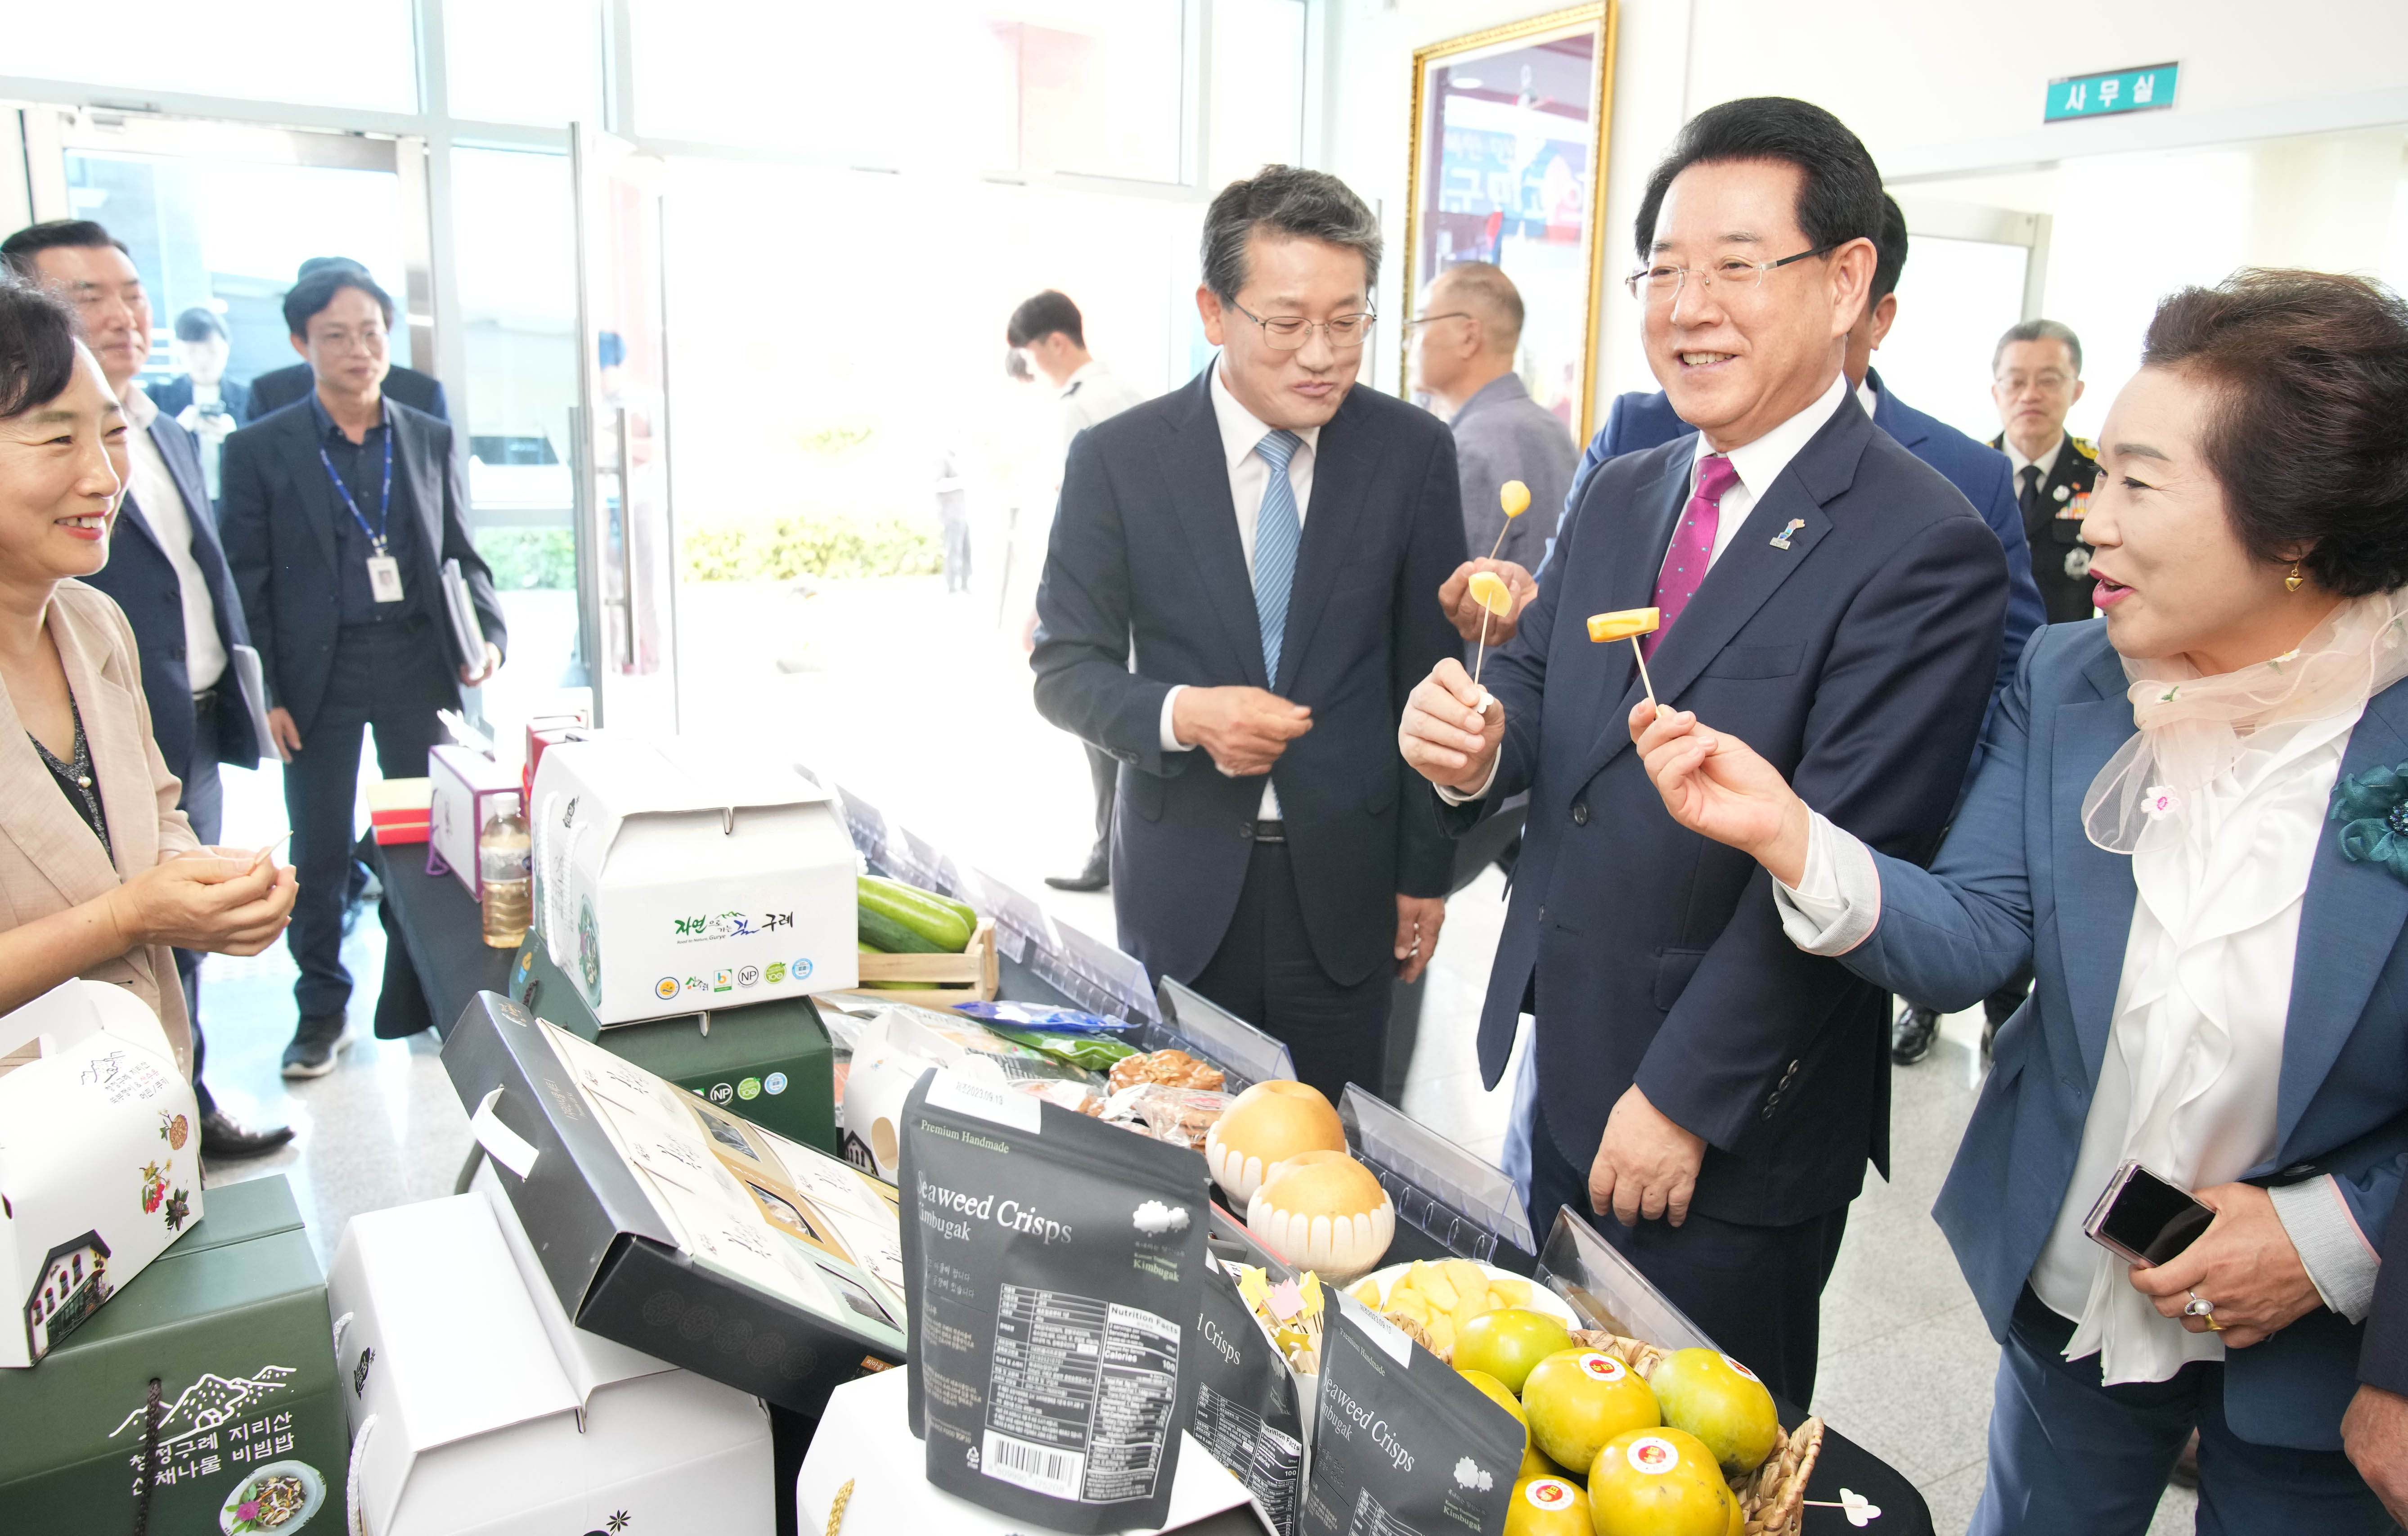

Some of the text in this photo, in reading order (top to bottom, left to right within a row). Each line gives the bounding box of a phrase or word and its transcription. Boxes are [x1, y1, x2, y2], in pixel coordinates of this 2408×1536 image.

[2065, 73, 2154, 111] 사무실
[761, 911, 793, 932] 구례
[741, 970, 756, 981] NP
[768, 972, 783, 980] 100
[129, 1061, 150, 1075] 지리산
[714, 1088, 730, 1100] NP
[741, 1088, 757, 1096] 100
[921, 1119, 1009, 1154] Premium Handmade
[918, 1170, 1072, 1246] Seaweed Crisps
[1133, 1259, 1180, 1282] Kimbugak
[1111, 1307, 1154, 1323] Nutrition
[1156, 1318, 1178, 1334] Facts
[1204, 1321, 1241, 1365] Crisps
[1339, 1327, 1385, 1377] Premium Handmade
[1105, 1350, 1176, 1372] Calories 100
[1323, 1365, 1375, 1430] Seaweed
[1371, 1419, 1415, 1473] Crisps
[129, 1411, 292, 1472] 청정구례 지리산
[233, 1432, 295, 1463] 비빔밥
[1262, 1422, 1285, 1440] Nutrition
[1286, 1437, 1300, 1451] Facts
[1256, 1452, 1270, 1469] Calories
[1443, 1506, 1482, 1533] Kimbugak
